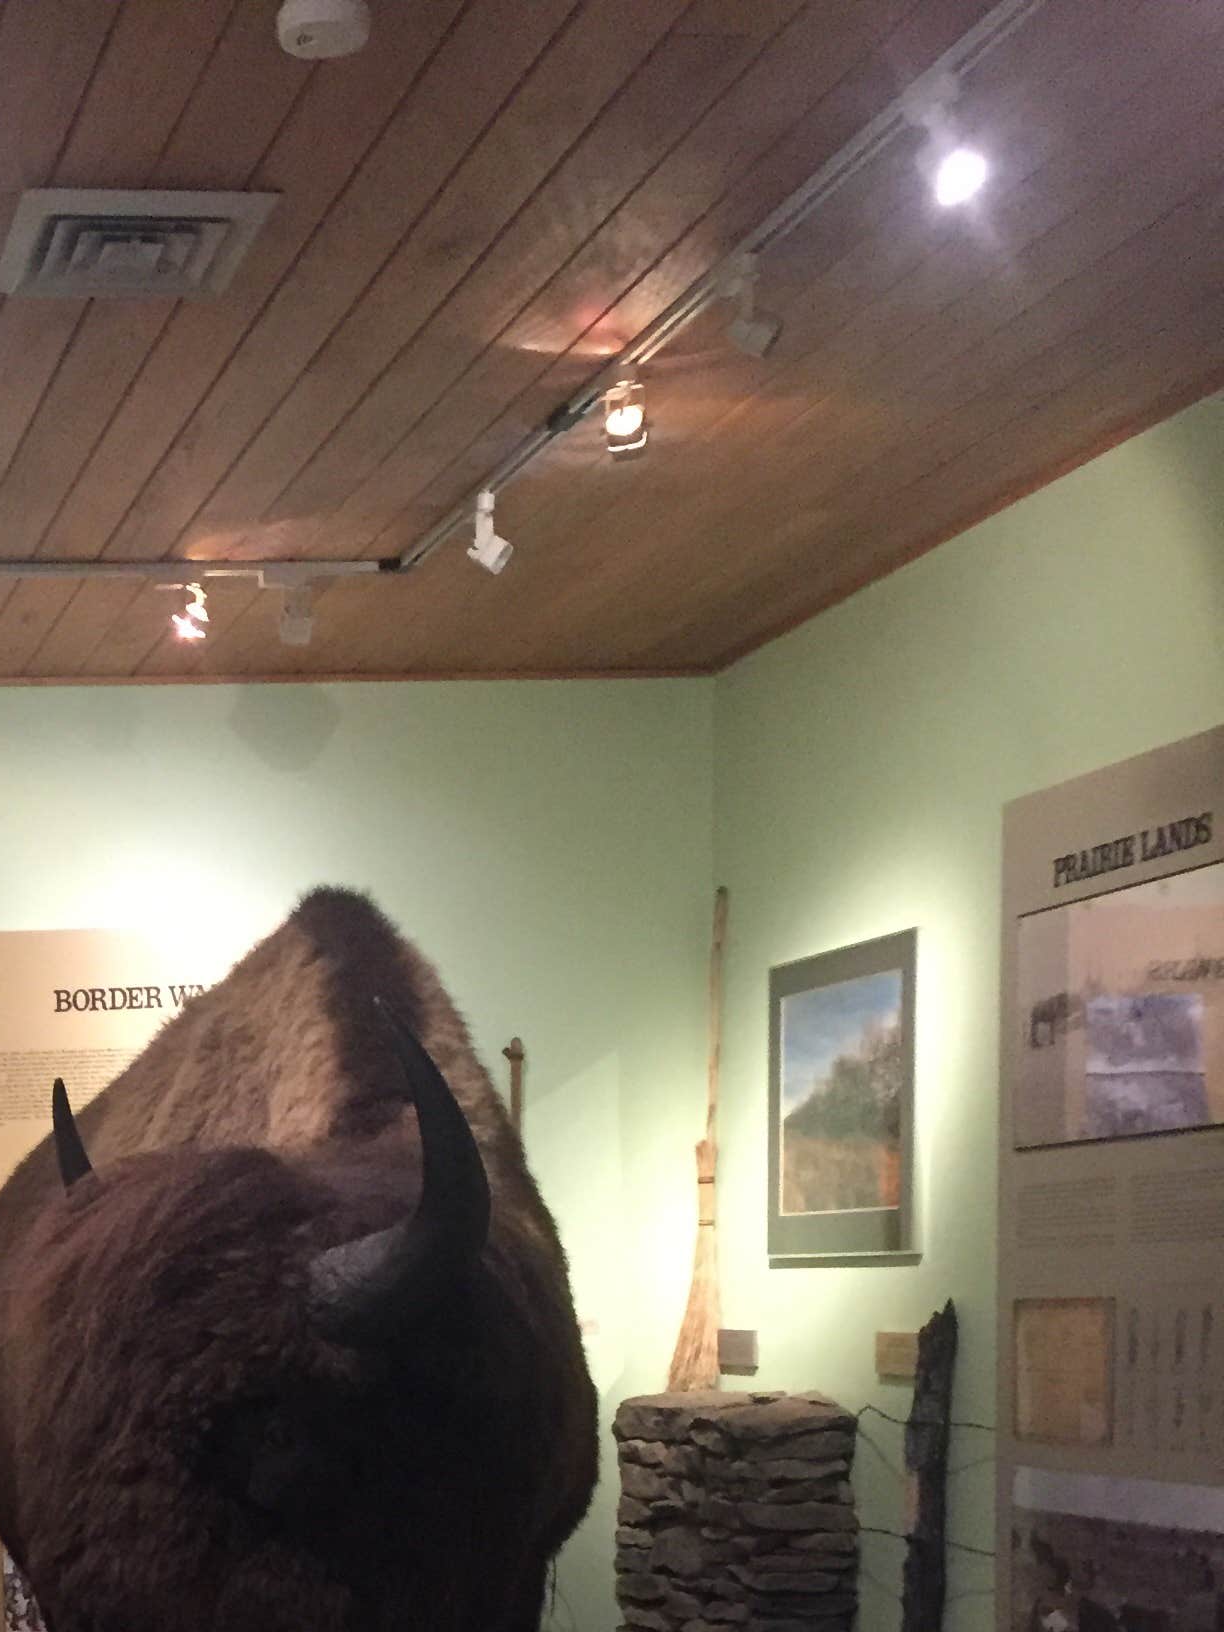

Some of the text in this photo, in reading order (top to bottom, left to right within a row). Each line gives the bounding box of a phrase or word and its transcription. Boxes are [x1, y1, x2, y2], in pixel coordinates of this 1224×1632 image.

[1053, 810, 1213, 888] PRAIRIE LANDS
[53, 986, 162, 1013] BORDER
